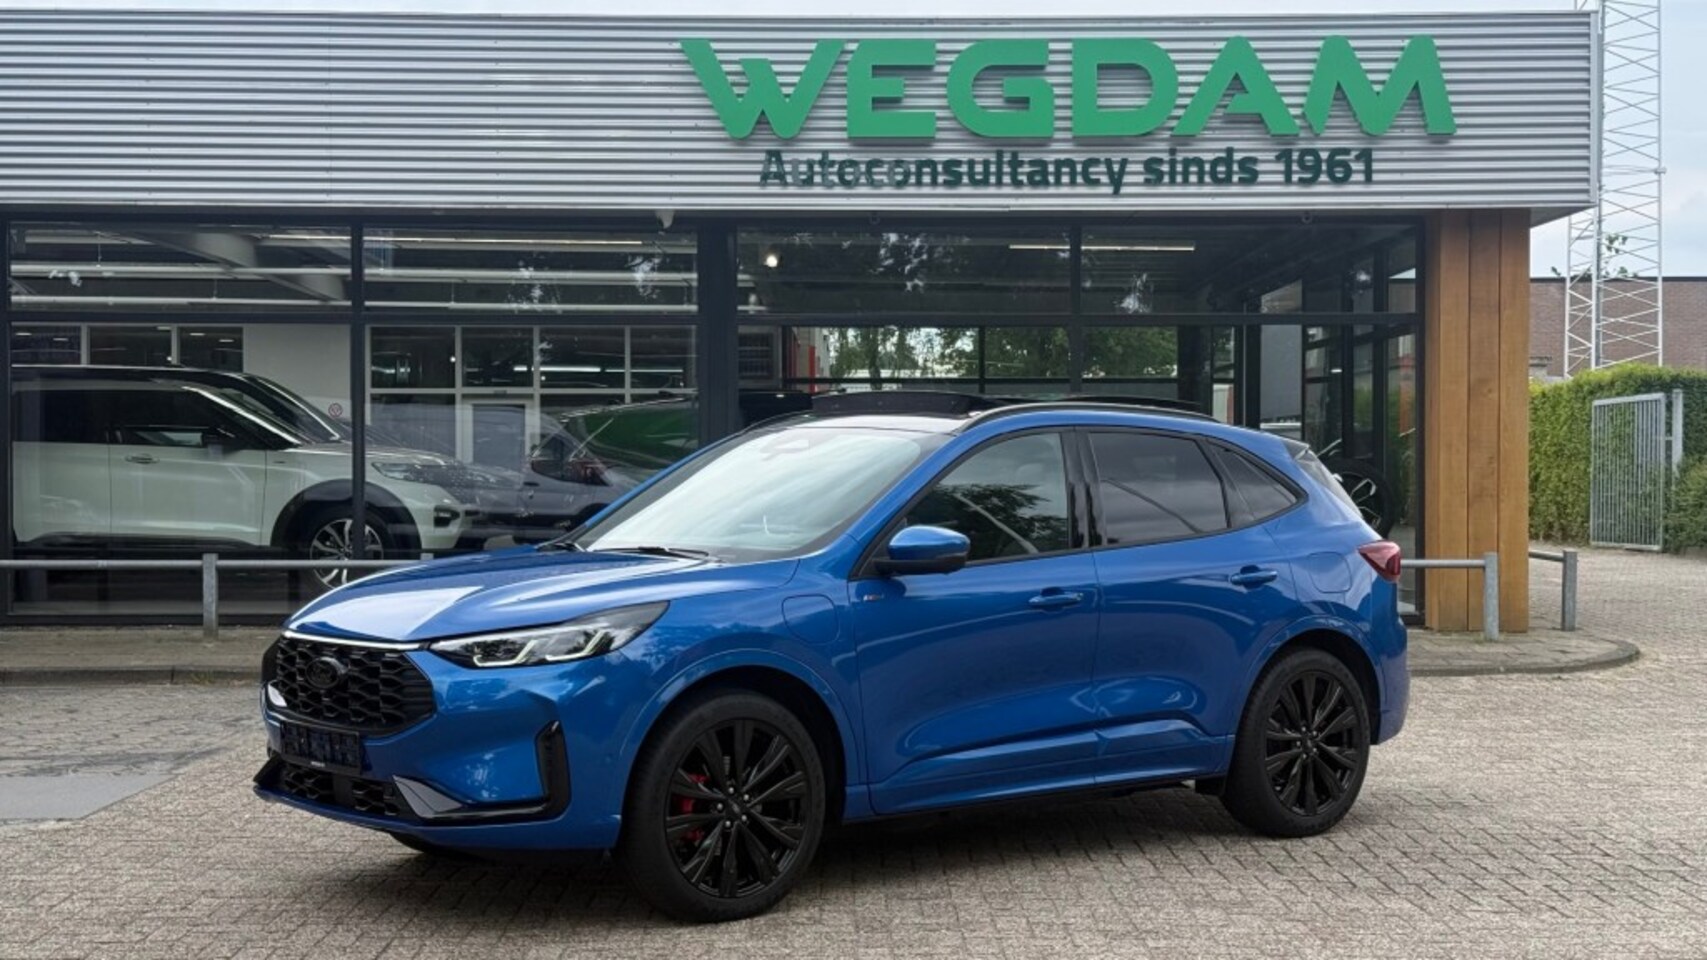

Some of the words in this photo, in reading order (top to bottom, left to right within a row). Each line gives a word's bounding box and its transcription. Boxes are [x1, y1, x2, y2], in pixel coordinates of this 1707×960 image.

[681, 36, 1456, 139] WEGDAM
[760, 149, 1128, 195] Autoconsultancy
[1143, 147, 1260, 184] sinds
[1275, 148, 1374, 184] 1961
